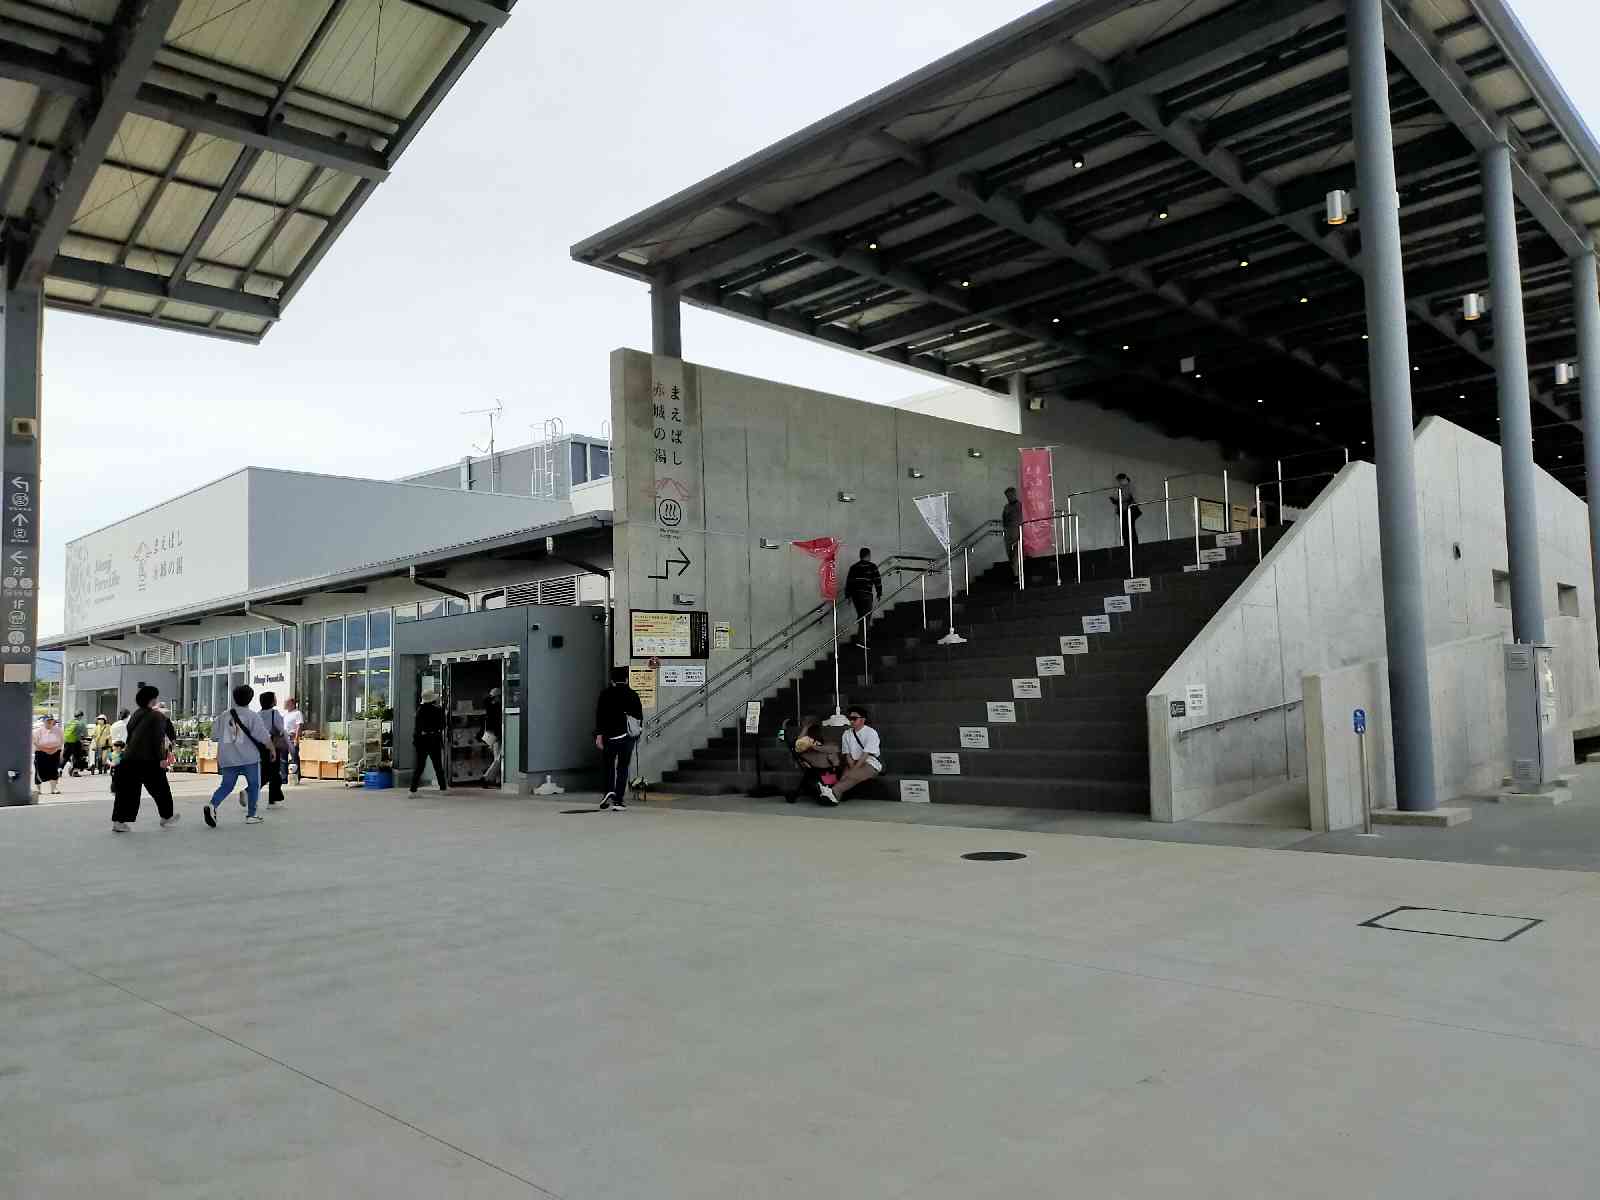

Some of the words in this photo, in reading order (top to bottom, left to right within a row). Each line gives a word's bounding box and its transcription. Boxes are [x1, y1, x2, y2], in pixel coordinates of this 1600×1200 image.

[653, 382, 667, 465] 赤城の湯
[670, 384, 683, 466] まえばし
[13, 567, 25, 577] 2F
[13, 599, 25, 609] 1F
